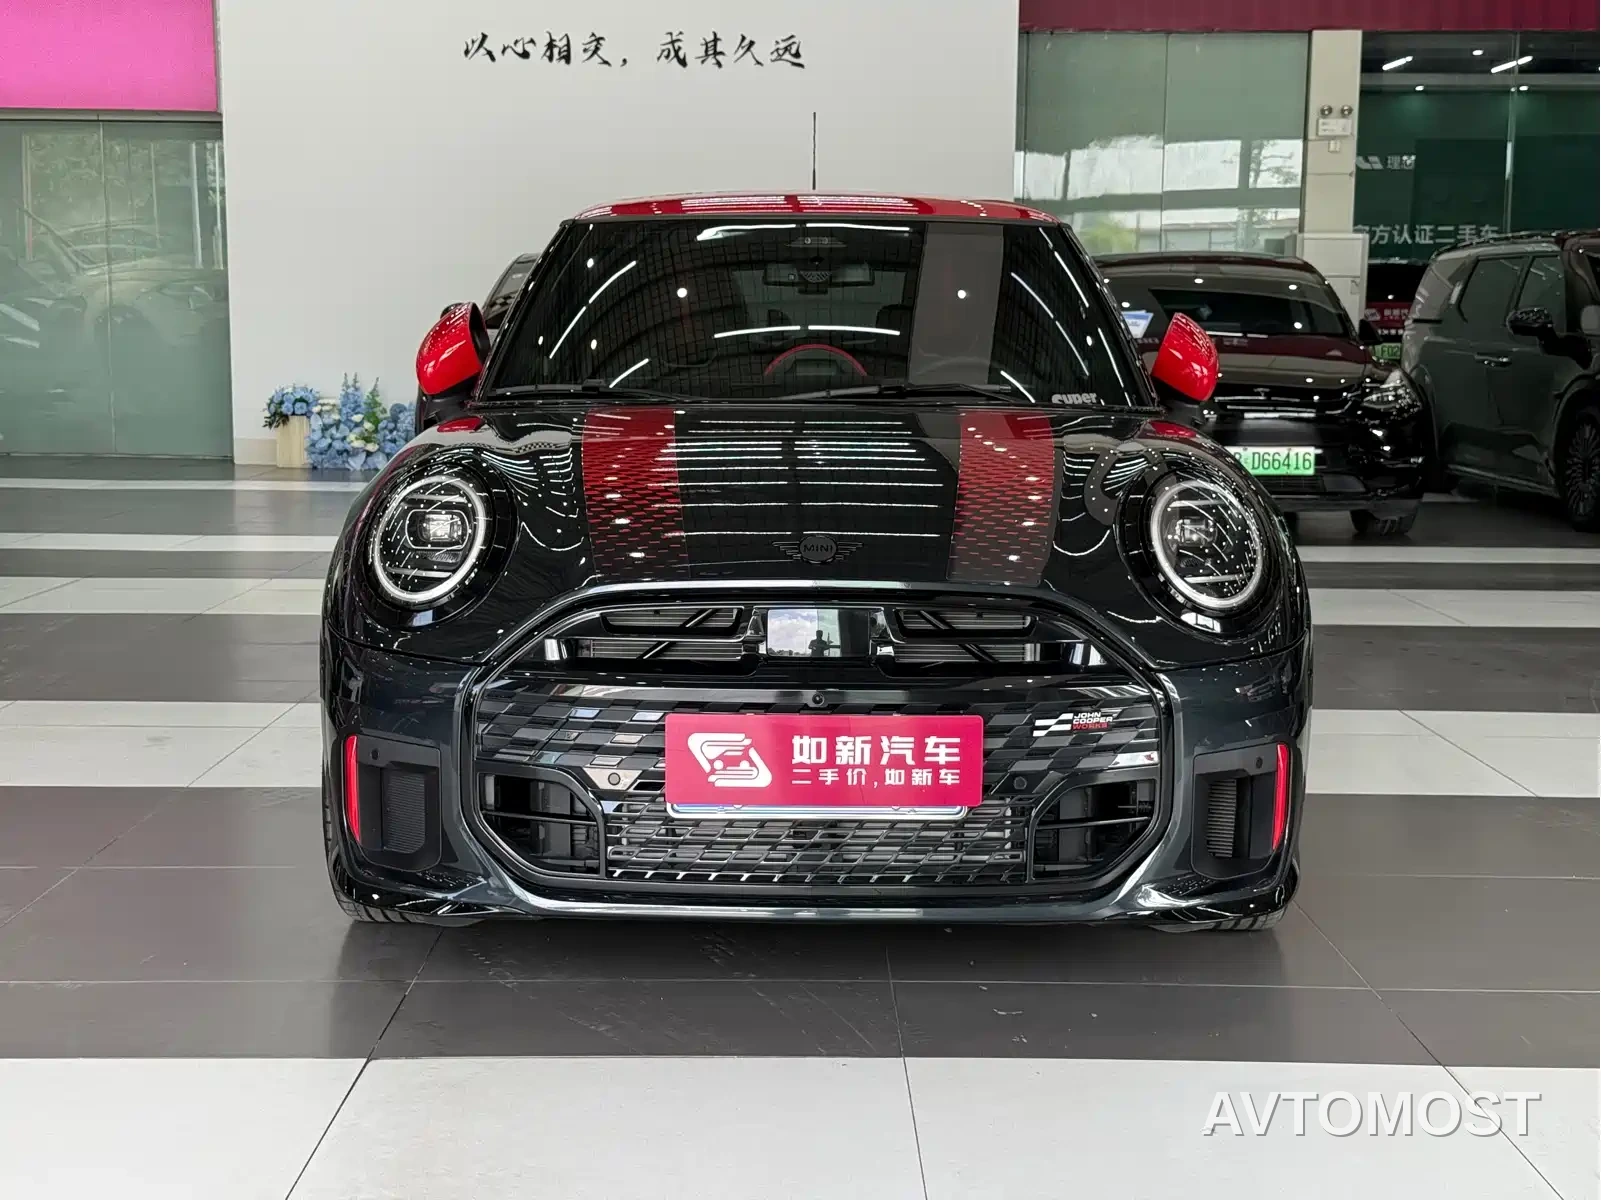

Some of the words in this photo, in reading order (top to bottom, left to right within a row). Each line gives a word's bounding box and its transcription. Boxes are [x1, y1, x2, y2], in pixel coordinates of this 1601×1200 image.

[803, 543, 834, 553] MINI
[1073, 716, 1113, 725] COOPER
[791, 735, 961, 766] 如新汽车
